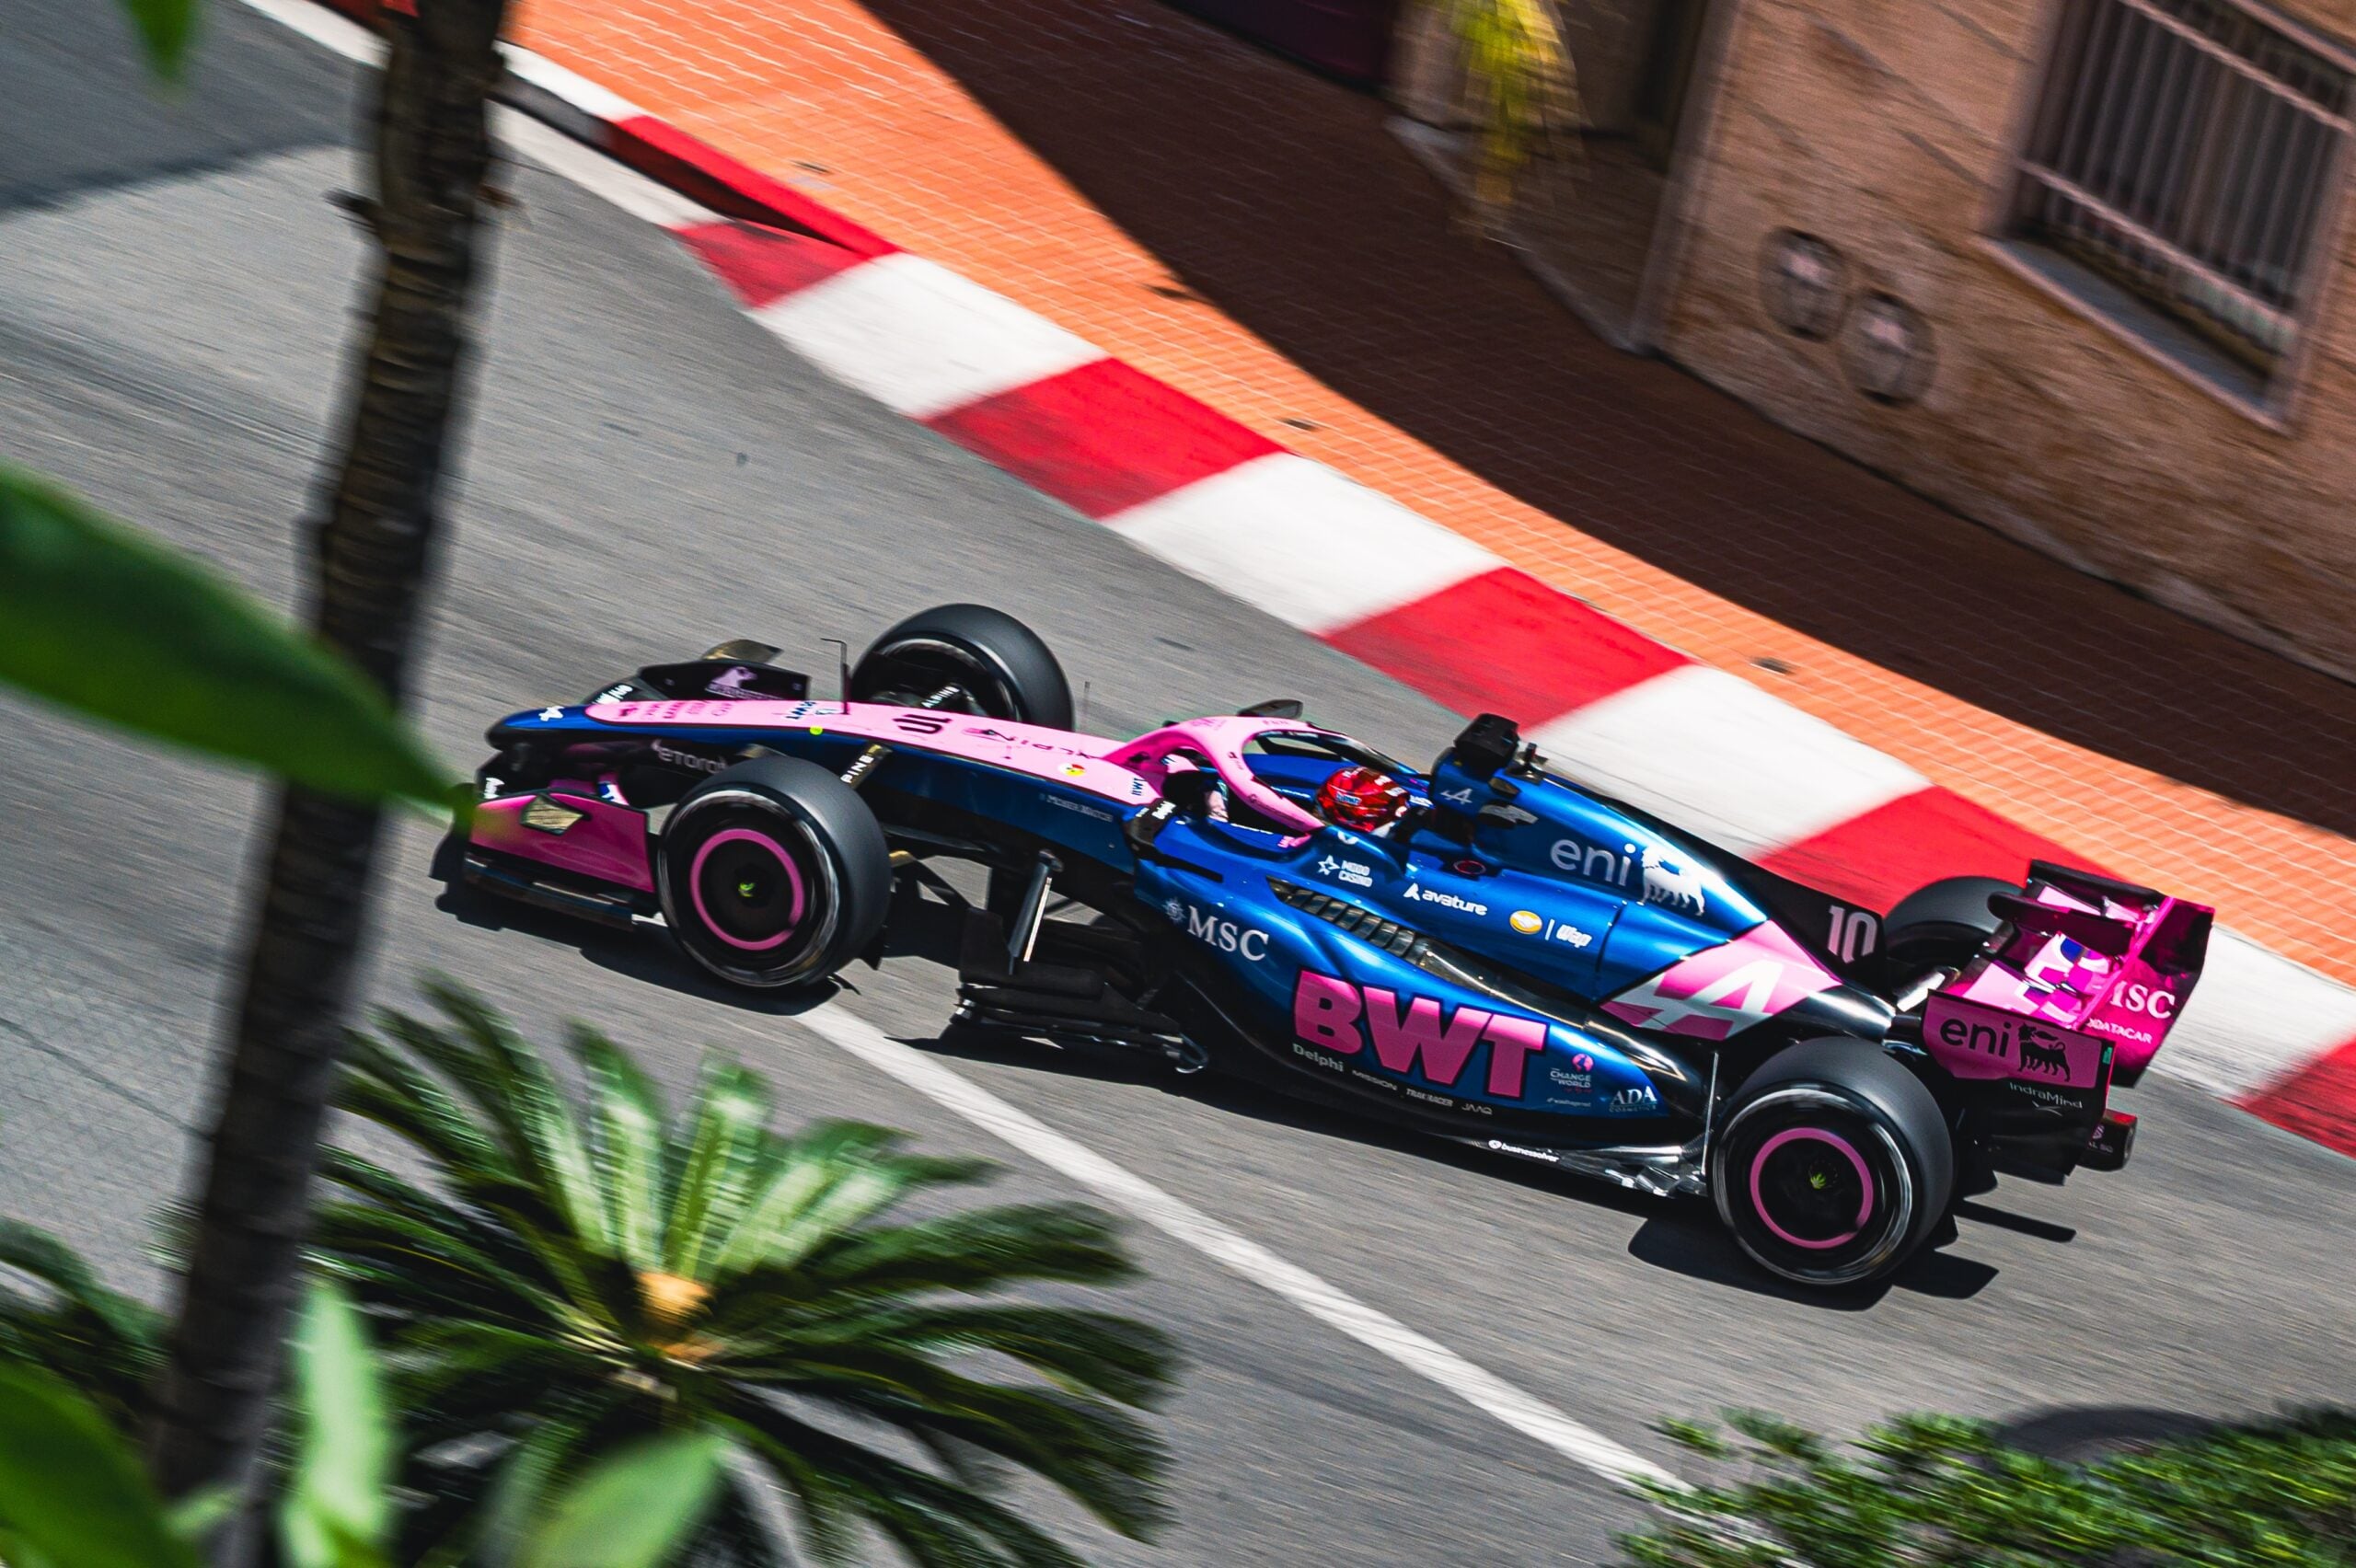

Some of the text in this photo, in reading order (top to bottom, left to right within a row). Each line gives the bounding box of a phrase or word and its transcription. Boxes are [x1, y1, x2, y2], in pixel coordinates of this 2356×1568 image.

[1550, 839, 1636, 886] eni
[1422, 890, 1487, 916] avature
[1188, 905, 1269, 961] MSC
[1827, 905, 1877, 963] 10
[1294, 970, 1548, 1098] BWT
[1939, 1015, 2013, 1057] eni
[1293, 1043, 1344, 1072] Delphi
[1550, 1070, 1591, 1082] CHANGE
[1558, 1079, 1590, 1088] WORLD
[1611, 1086, 1657, 1105] ADA
[2010, 1082, 2084, 1109] IndraMind
